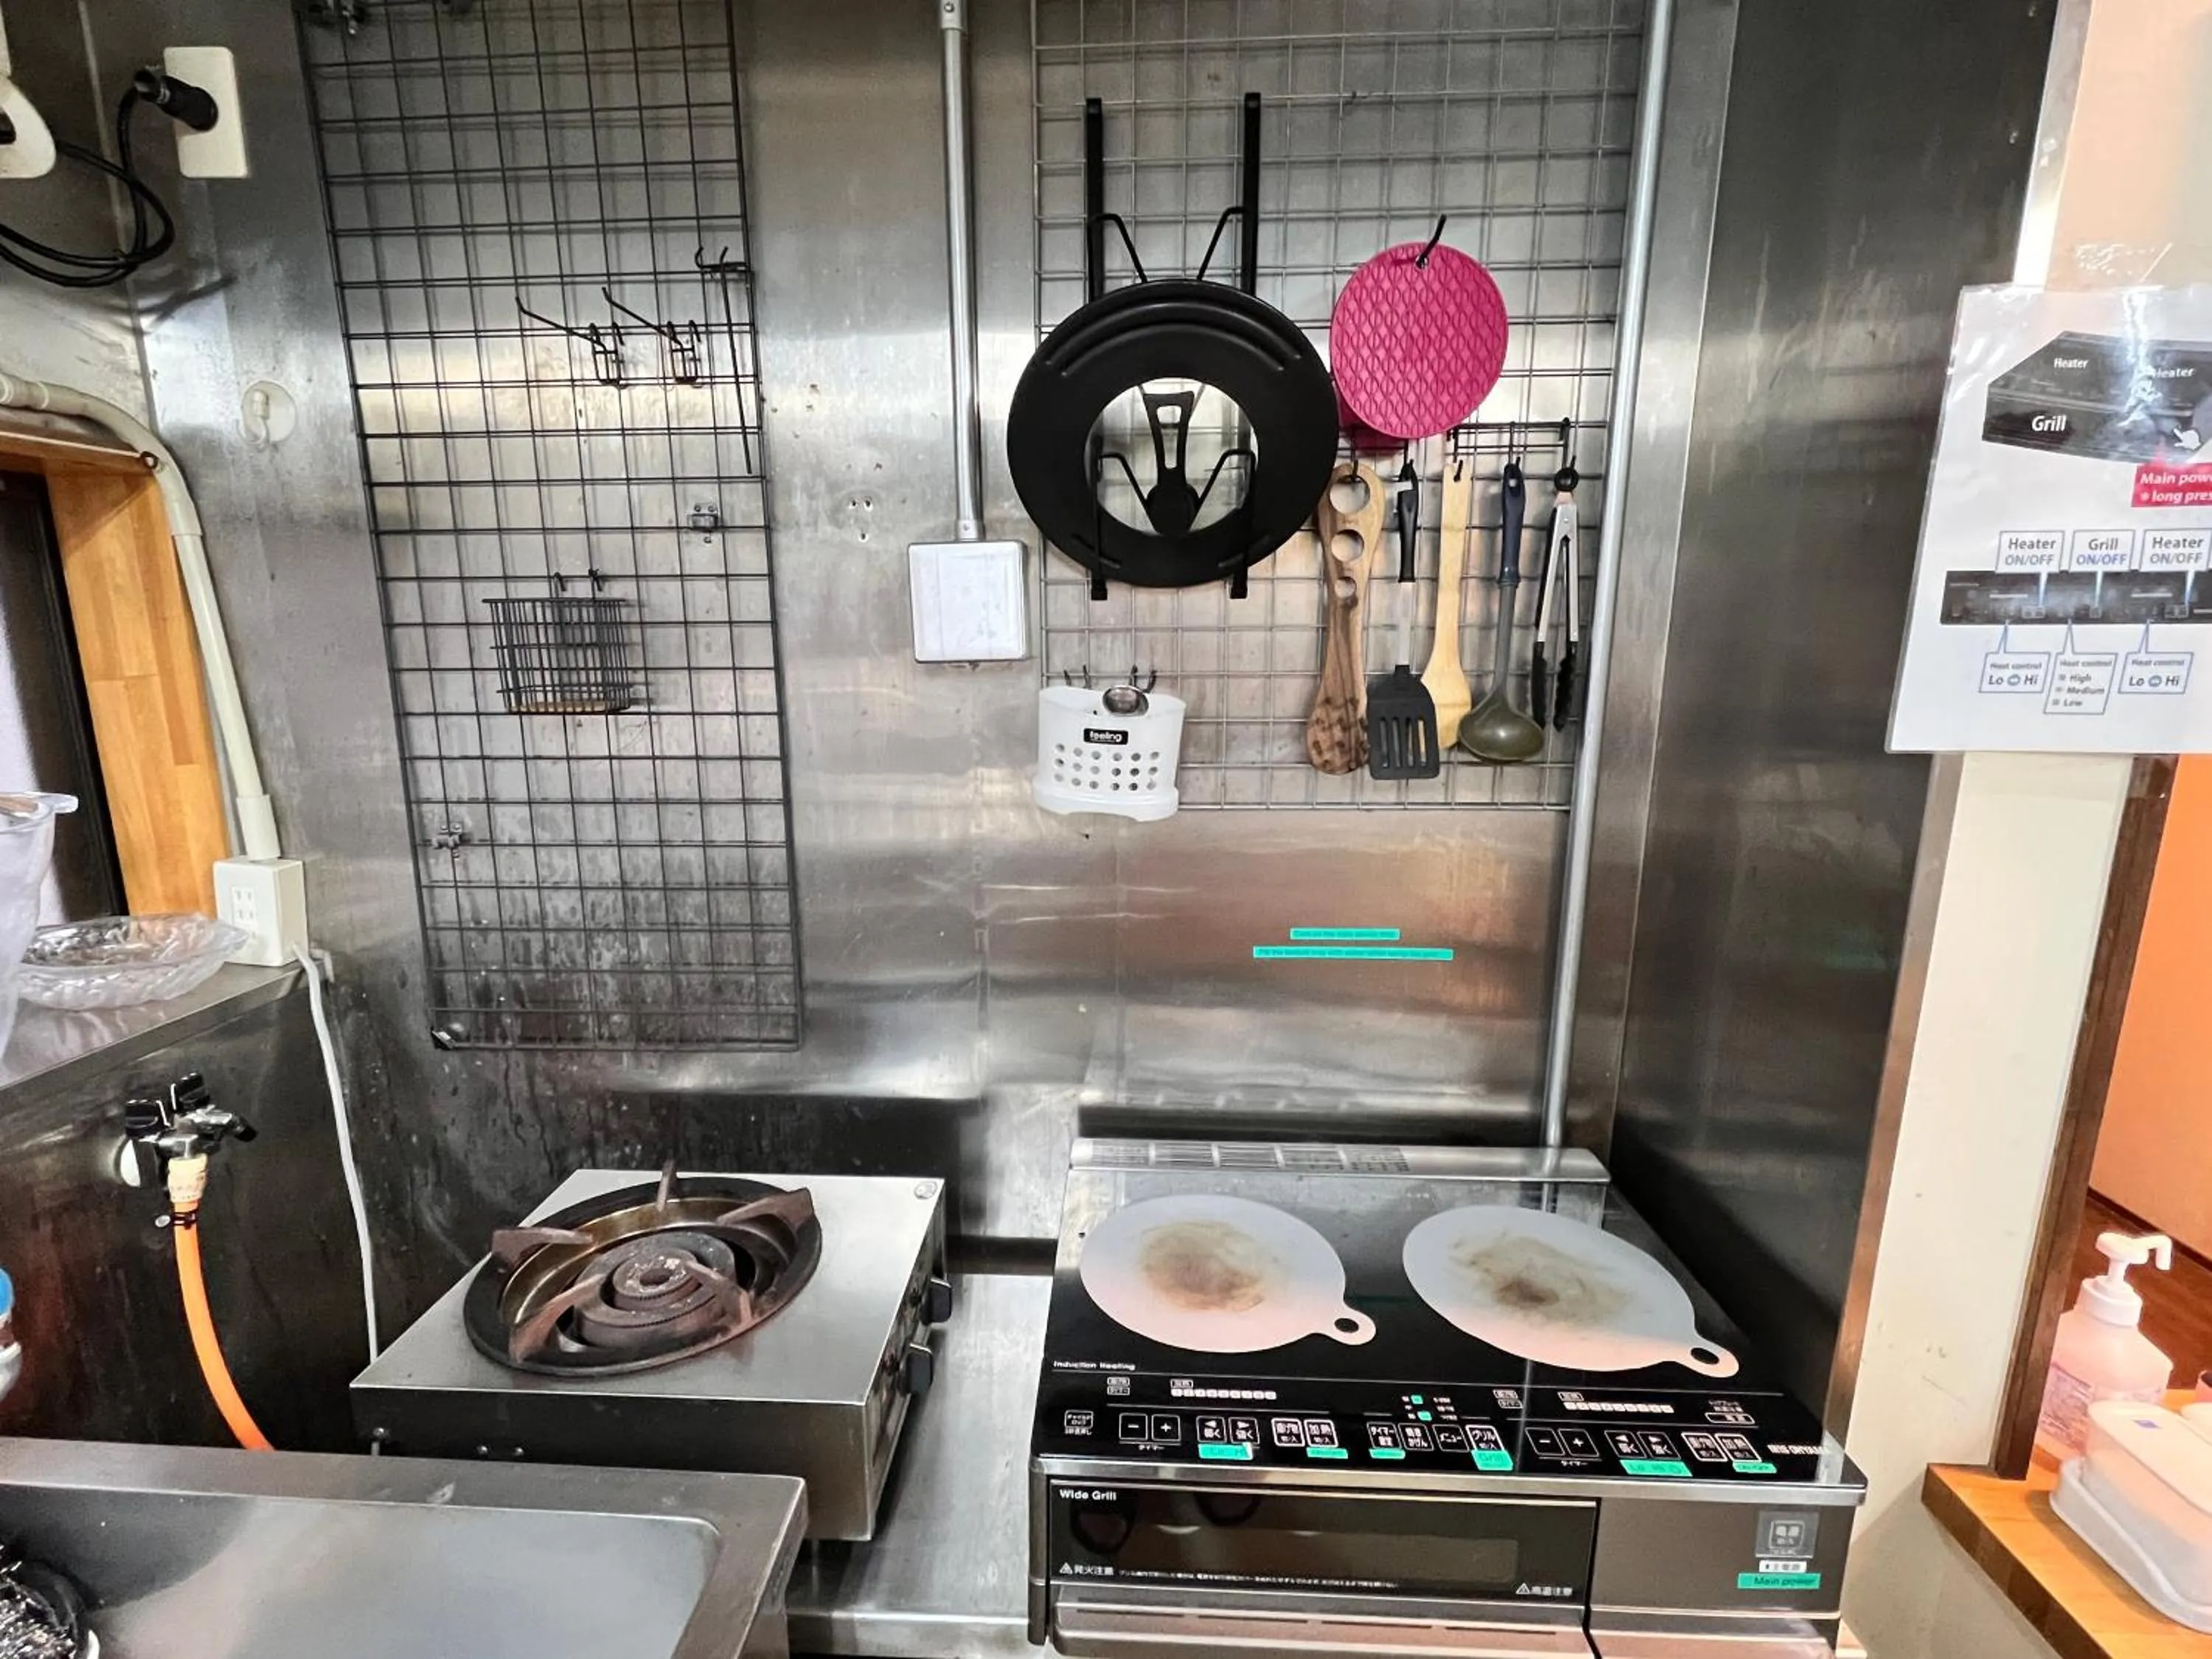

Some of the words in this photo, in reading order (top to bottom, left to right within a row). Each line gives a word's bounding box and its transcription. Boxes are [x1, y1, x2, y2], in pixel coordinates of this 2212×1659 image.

[2053, 358, 2089, 369] Heater
[2031, 414, 2067, 432] Grill
[2140, 472, 2176, 484] Main
[2178, 474, 2212, 487] pow
[2152, 490, 2183, 504] long
[2008, 538, 2056, 550] Heater
[2088, 538, 2118, 551] Grill
[2152, 537, 2204, 549] Heater
[2005, 554, 2053, 566] ON/OFF
[2076, 554, 2126, 565] ON/OFF
[2149, 552, 2202, 565] ON/OFF
[1989, 675, 2004, 685] Lo
[2024, 675, 2039, 685] Hi
[2129, 675, 2145, 686] Lo
[2166, 675, 2180, 686] Hi
[1060, 1489, 1089, 1500] Wide
[1092, 1490, 1116, 1500] Grill
[1754, 1576, 1780, 1585] Main
[1781, 1578, 1816, 1587] power
